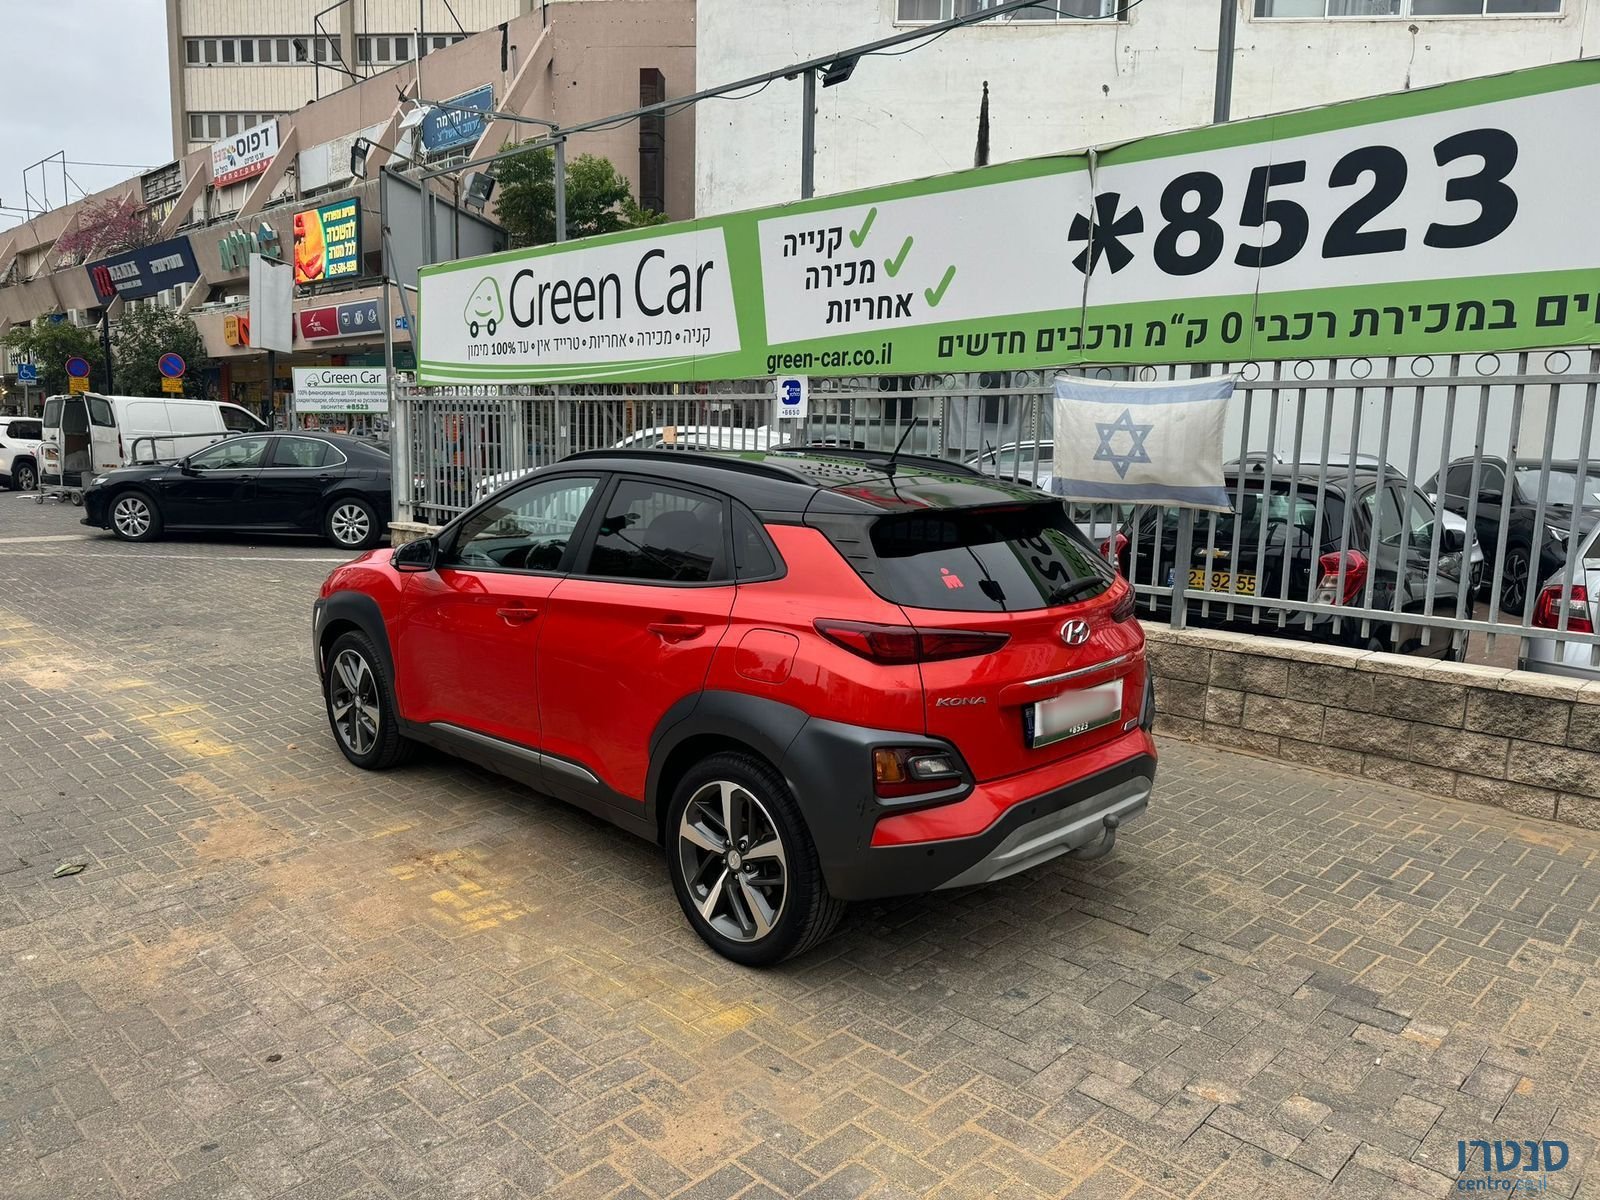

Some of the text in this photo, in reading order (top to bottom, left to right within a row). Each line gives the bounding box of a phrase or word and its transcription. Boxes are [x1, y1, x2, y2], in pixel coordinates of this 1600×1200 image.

[436, 110, 462, 129] קדימה
[236, 128, 269, 157] דפוס
[327, 220, 356, 243] להשכרה
[783, 226, 843, 259] קנייה
[345, 241, 356, 256] לכל
[509, 248, 714, 328] Green Car
[805, 259, 876, 290] מכירה
[825, 292, 914, 324] אחריות
[1349, 299, 1517, 338] במכירת
[1035, 322, 1133, 353] ורכבים
[1220, 311, 1243, 344] 0
[1254, 311, 1337, 342] רכבי
[467, 327, 711, 360] קניה מכירה אחריות טרייד אין עד 100% מימון
[766, 342, 893, 374] green-car.co.il
[937, 330, 1026, 358] חדשים
[321, 371, 381, 384] Green Car
[935, 695, 988, 707] KONA
